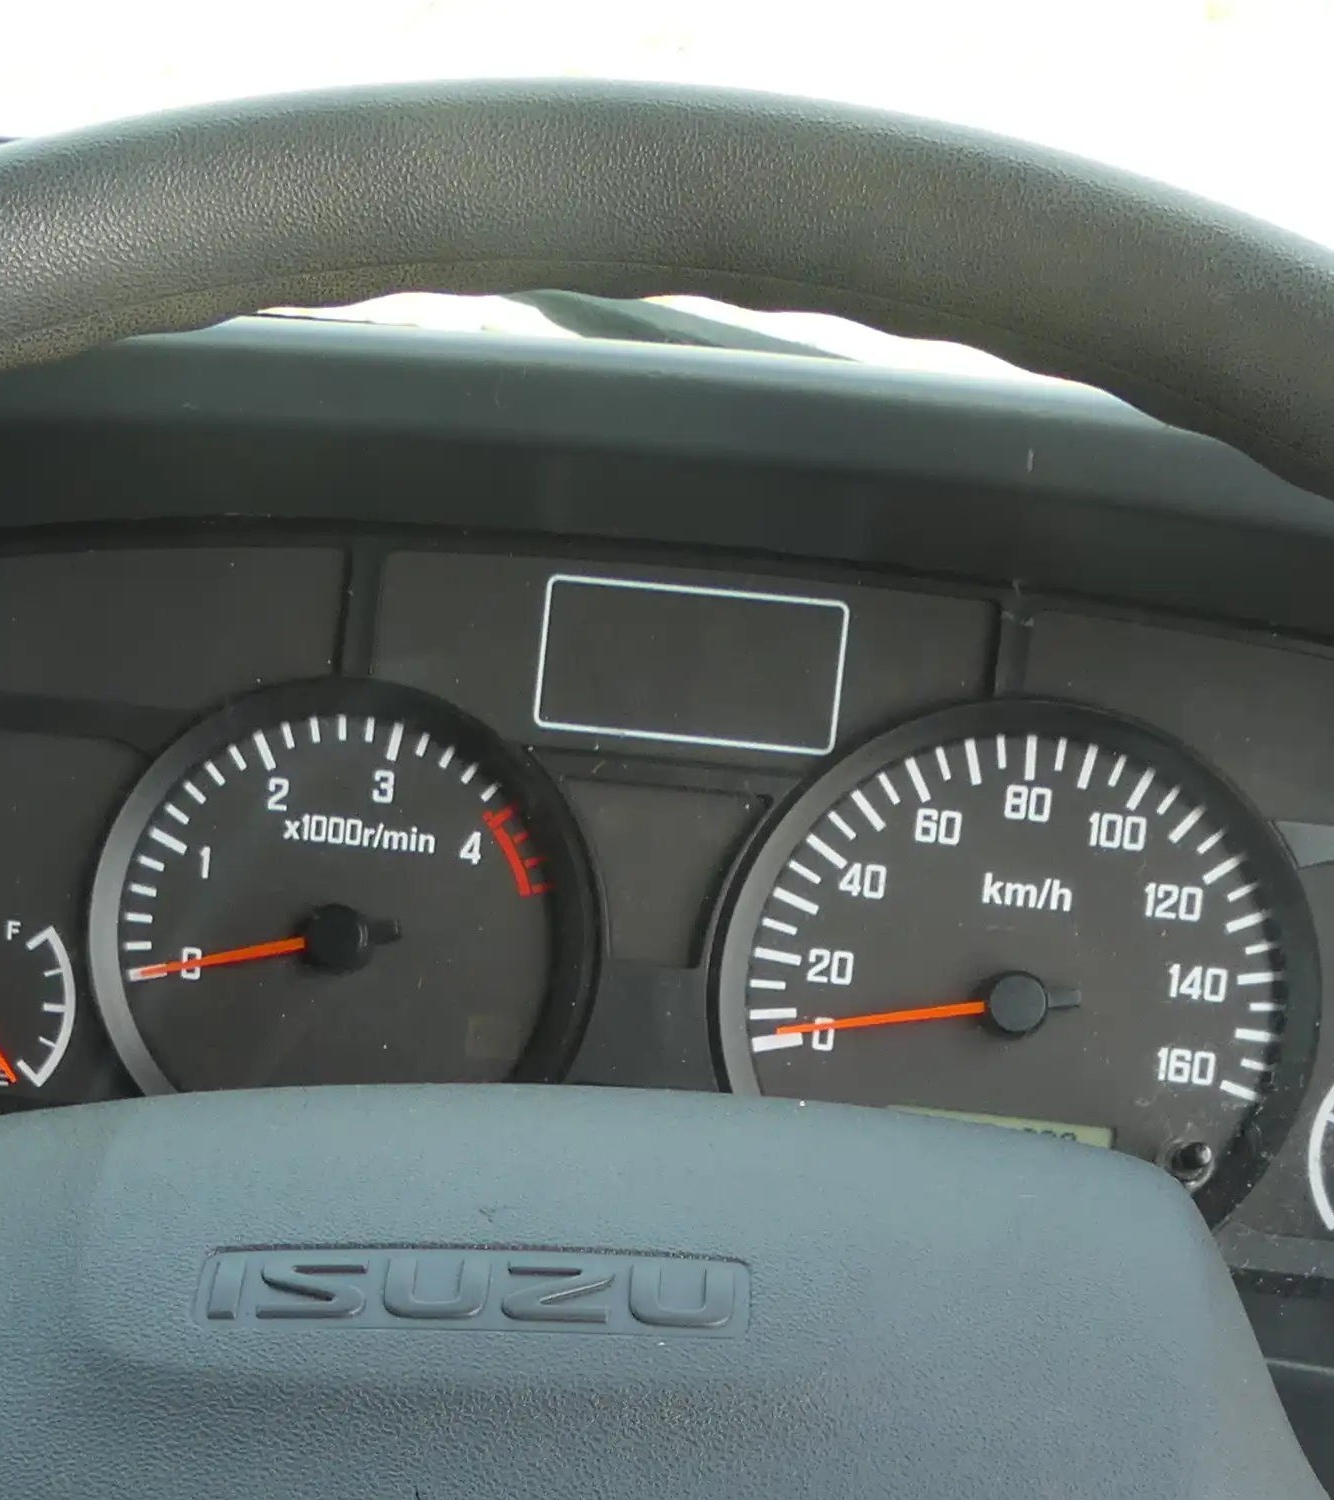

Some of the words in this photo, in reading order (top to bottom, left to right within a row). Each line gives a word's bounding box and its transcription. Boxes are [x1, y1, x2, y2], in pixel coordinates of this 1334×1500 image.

[268, 777, 290, 812] 2
[372, 769, 395, 804] 3
[1004, 785, 1052, 823] 80
[283, 813, 436, 854] x1000r/min
[914, 809, 963, 846] 60
[1089, 812, 1147, 851] 100
[199, 845, 211, 879] 1
[460, 830, 482, 865] 4
[838, 864, 886, 900] 40
[982, 873, 1073, 911] km/h
[1144, 882, 1203, 922] 120
[7, 920, 21, 940] F
[180, 947, 202, 980] 0
[807, 948, 854, 985] 20
[1169, 963, 1227, 1003] 140
[811, 1017, 835, 1052] 0
[1157, 1047, 1216, 1087] 160
[207, 1257, 736, 1329] ISUZU
